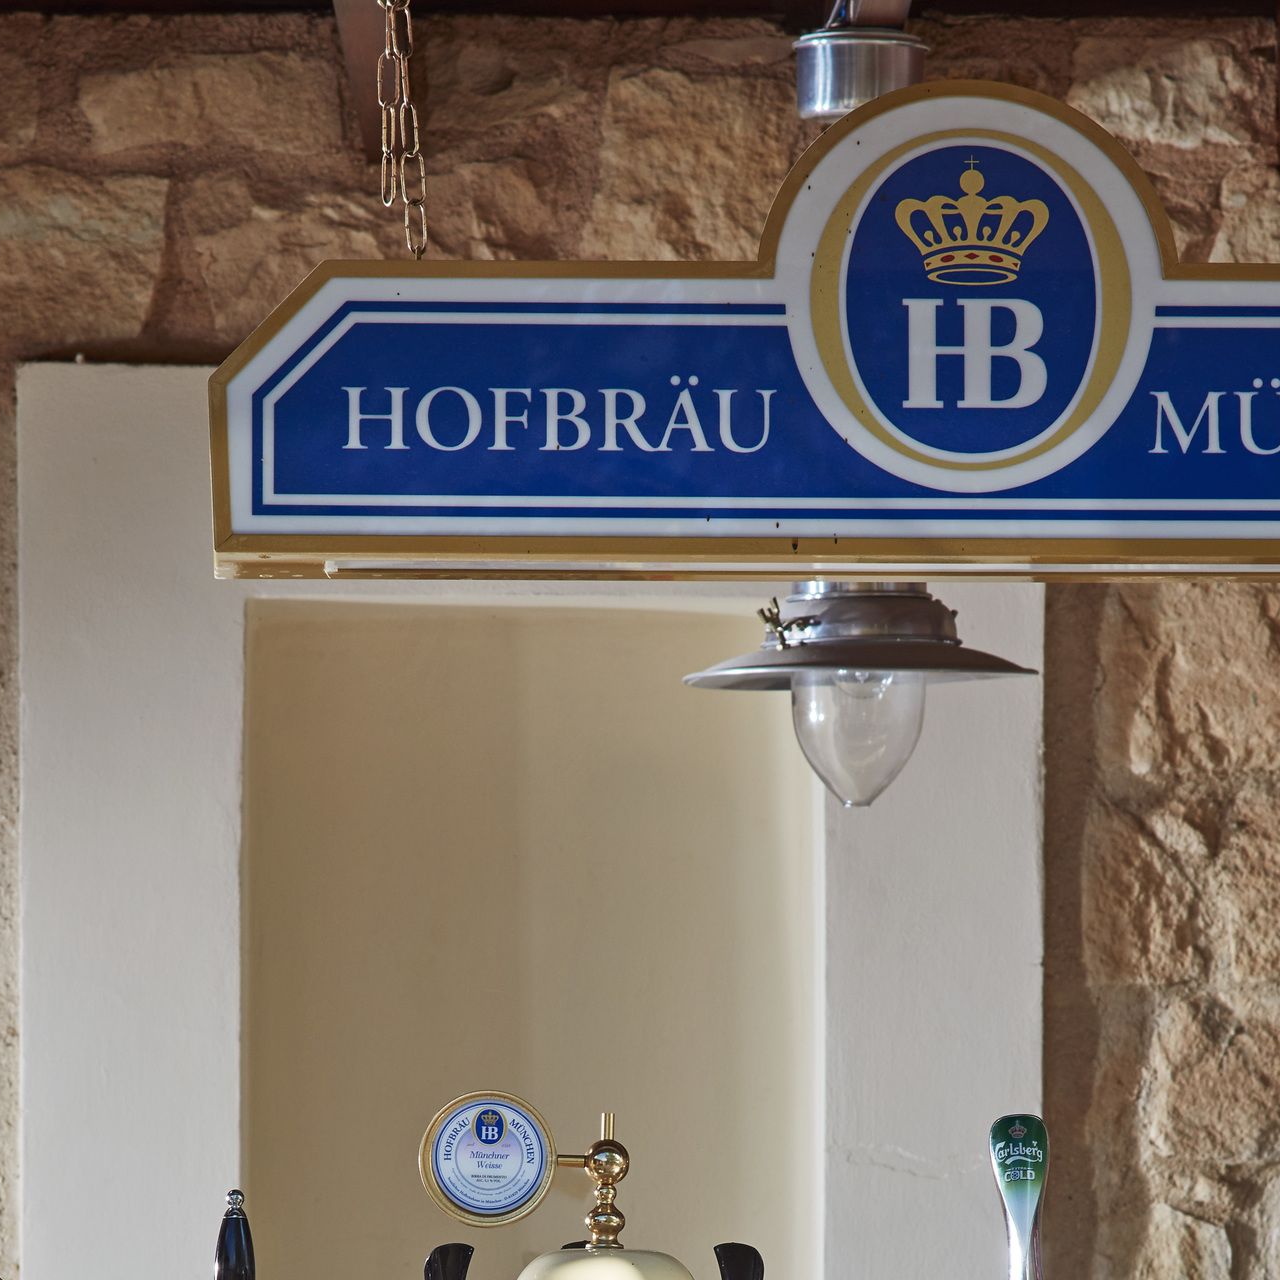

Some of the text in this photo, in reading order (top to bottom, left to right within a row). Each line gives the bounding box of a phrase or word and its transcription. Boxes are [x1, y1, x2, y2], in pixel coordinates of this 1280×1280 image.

[902, 298, 1048, 409] HB
[340, 374, 777, 453] HOFBRÄU
[443, 1117, 535, 1165] HOFBRÄU MÜNCHEN
[481, 1126, 498, 1140] HB
[469, 1151, 510, 1160] Münchner
[995, 1141, 1043, 1164] Carlsberg
[477, 1161, 503, 1169] Weisse
[1004, 1170, 1035, 1181] COLD
